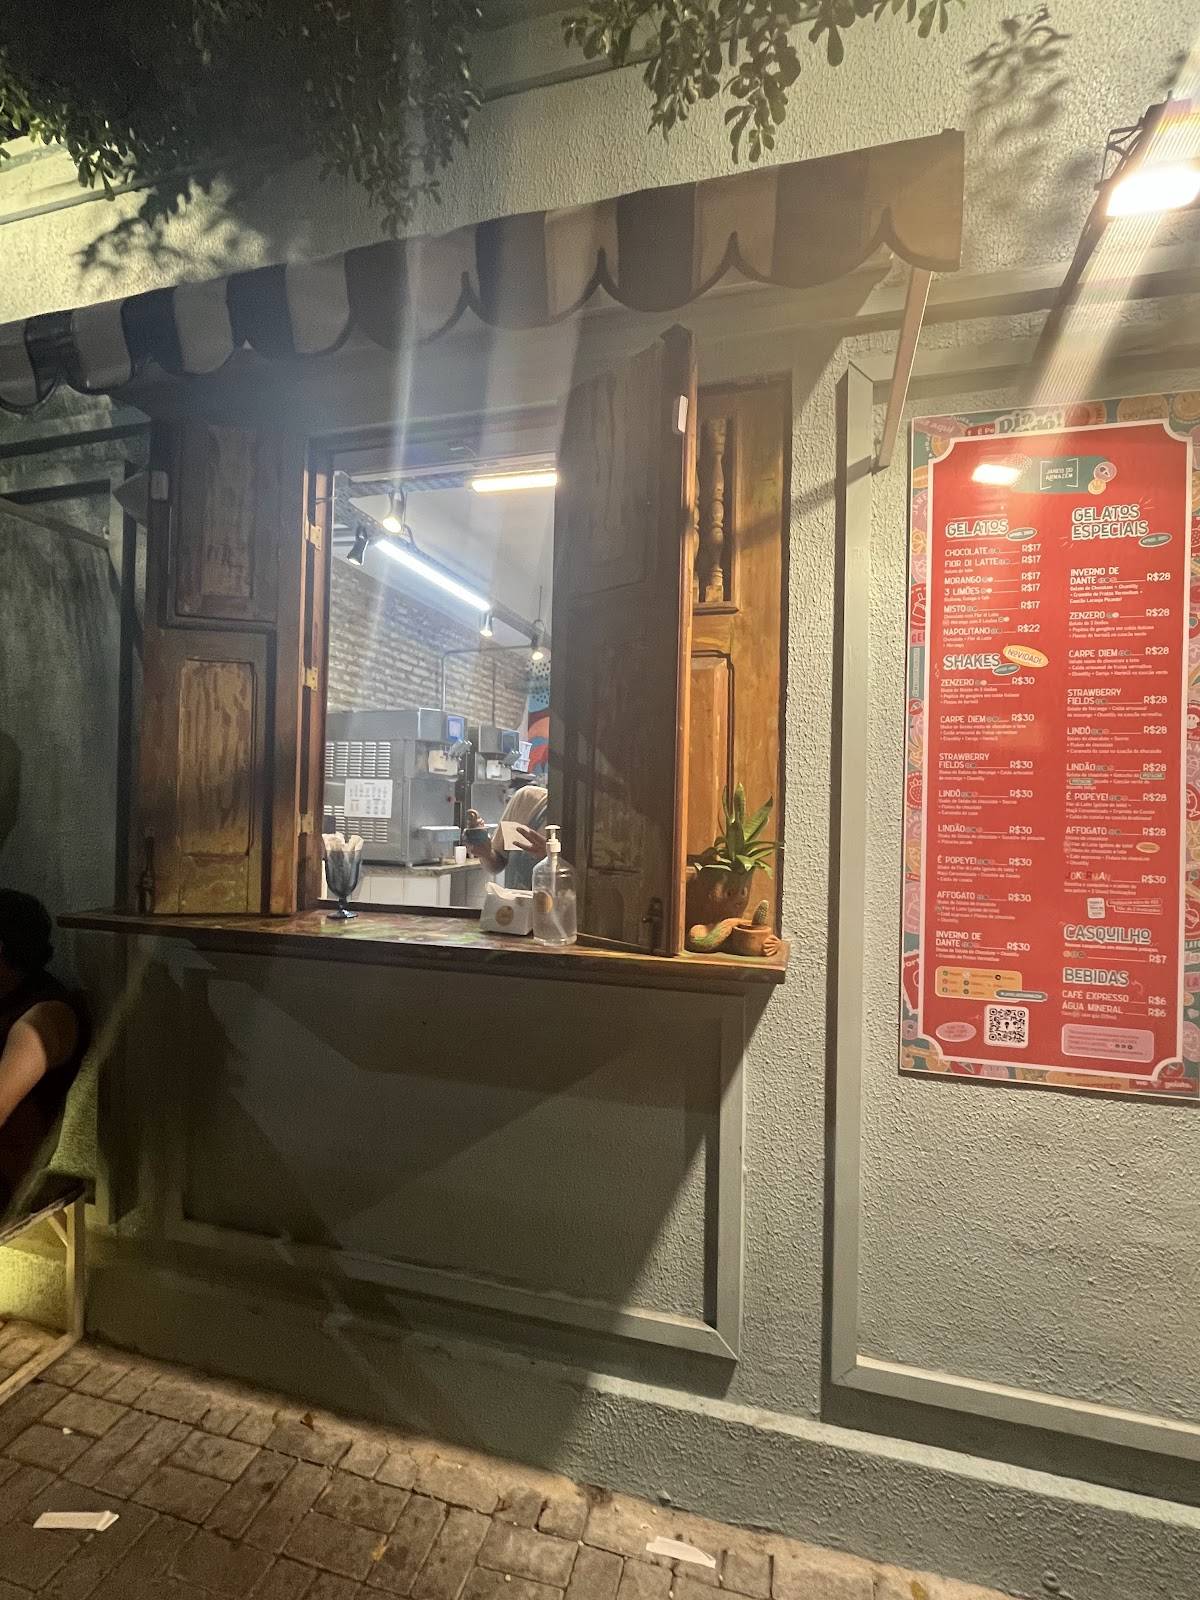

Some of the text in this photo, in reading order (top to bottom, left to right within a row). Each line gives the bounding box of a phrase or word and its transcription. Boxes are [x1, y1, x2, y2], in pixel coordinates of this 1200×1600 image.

[1072, 504, 1140, 524] GELATOS
[946, 519, 1008, 538] GELATOS
[1072, 521, 1149, 541] ESPECIAIS
[944, 543, 1041, 556] CHOCOLATE R$17
[944, 555, 1041, 568] FIOR DI LATTE R$17
[1070, 566, 1120, 576] INVERNO DE
[944, 572, 1040, 585] MORANGO R$17
[1070, 572, 1171, 585] DANTE R$28
[952, 586, 980, 596] LIMÕES
[1020, 583, 1040, 592] R$17
[944, 600, 1040, 613] MISTO R$17
[1069, 608, 1170, 620] ZENZERO R$28
[943, 624, 1040, 635] NAPOLITANO R$22
[1068, 646, 1170, 658] CARPE DIEM R$28
[944, 653, 1000, 670] SHAKES
[940, 676, 1035, 686] ZENZERO R$30
[1067, 688, 1122, 697] STRAWBERRY
[1067, 695, 1168, 705] FIELDS R$28
[968, 715, 986, 723] DIEM
[1011, 713, 1035, 722] R$30
[1143, 726, 1168, 734] R$28
[938, 752, 990, 760] STRAWBERRY
[938, 760, 1034, 769] FIELDS R$30
[1066, 762, 1167, 772] LINDÃO R$28
[1009, 789, 1034, 798] R$30
[1142, 792, 1167, 802] R$28
[938, 823, 1032, 834] LINDÃO R$30
[1065, 826, 1167, 836] AFFOGATO R$28
[1008, 857, 1032, 866] R$30
[1141, 874, 1167, 884] R$30
[936, 890, 1032, 902] AFFOGATO R$30
[936, 930, 982, 941] INVERNO DE
[1064, 924, 1152, 944] CASQUILHO
[936, 938, 1031, 952] DANTE R$30
[1148, 954, 1168, 964] R$7
[1063, 967, 1129, 987] BEBIDAS
[1062, 990, 1167, 1006] CAFÉ EXPRESSO R$6
[1062, 1000, 1167, 1017] ÁGUA MINERAL R$6
